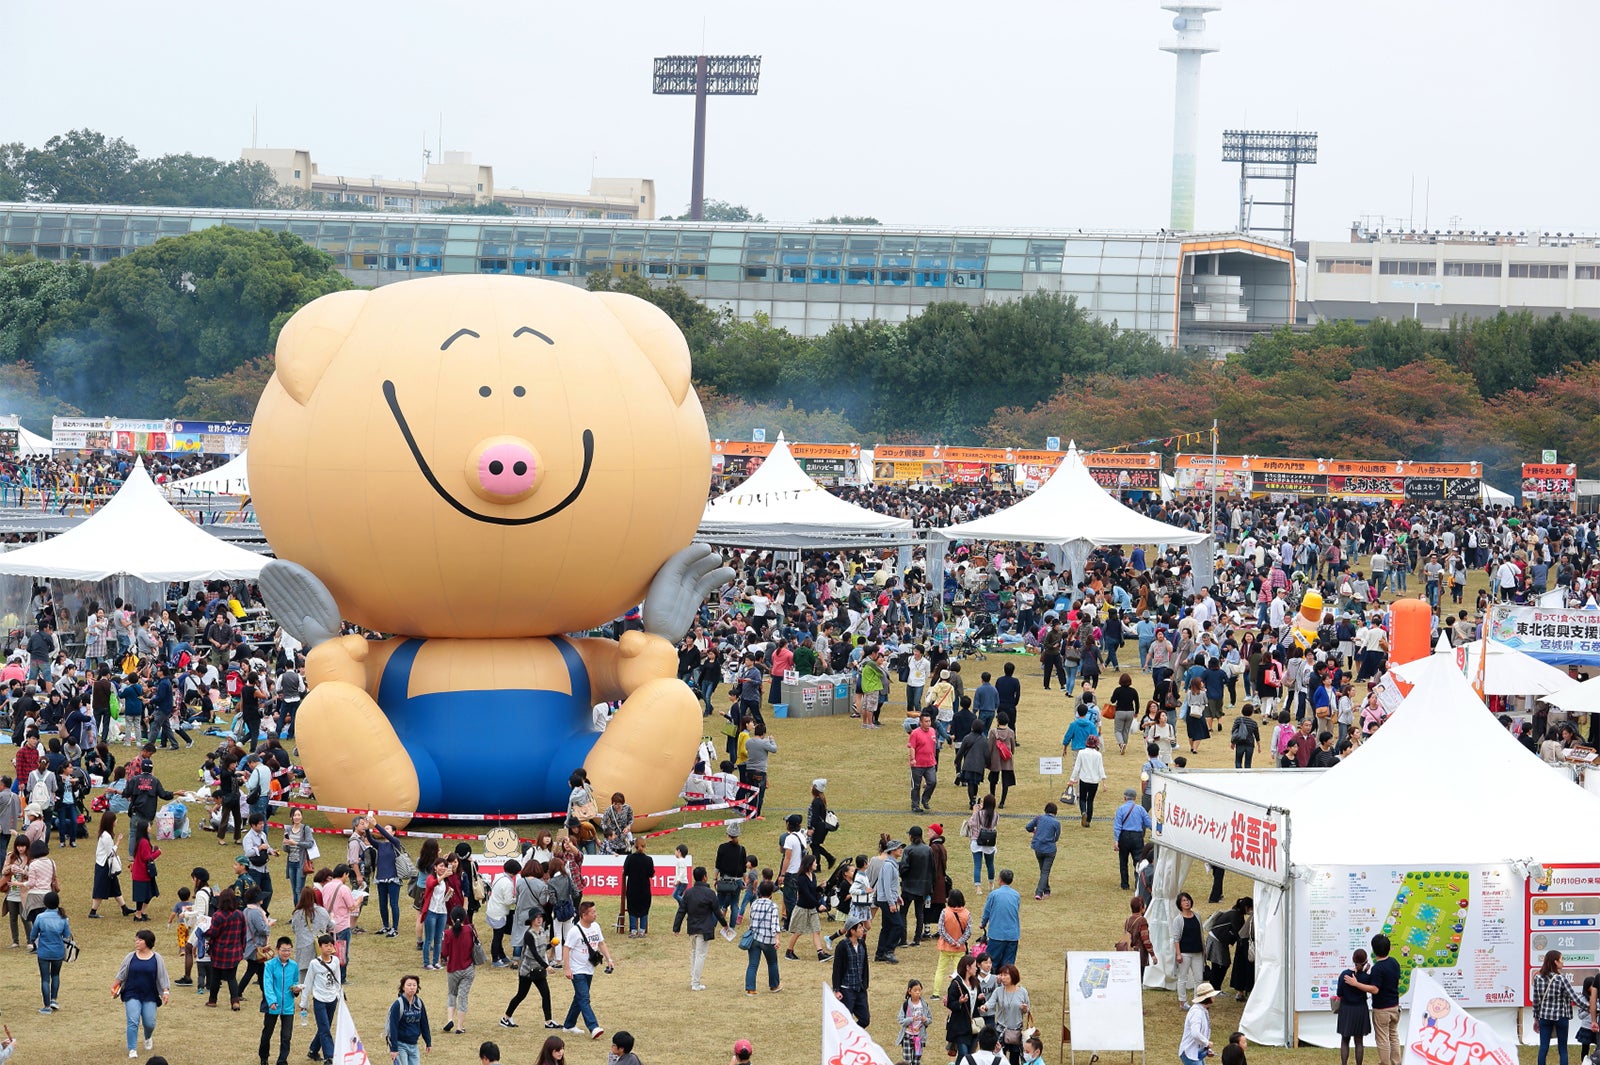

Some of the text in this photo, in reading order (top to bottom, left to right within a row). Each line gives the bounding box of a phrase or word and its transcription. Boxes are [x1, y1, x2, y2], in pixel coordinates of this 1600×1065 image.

[882, 449, 926, 457] コロッケ倶楽部
[1358, 465, 1387, 473] 小山商店
[1537, 479, 1571, 492] 牛とろ丼
[1540, 639, 1574, 651] 宮城県
[1165, 802, 1278, 873] 人気グルメランキング 投票所
[1559, 901, 1575, 912] 1位
[1558, 936, 1575, 948] 2位
